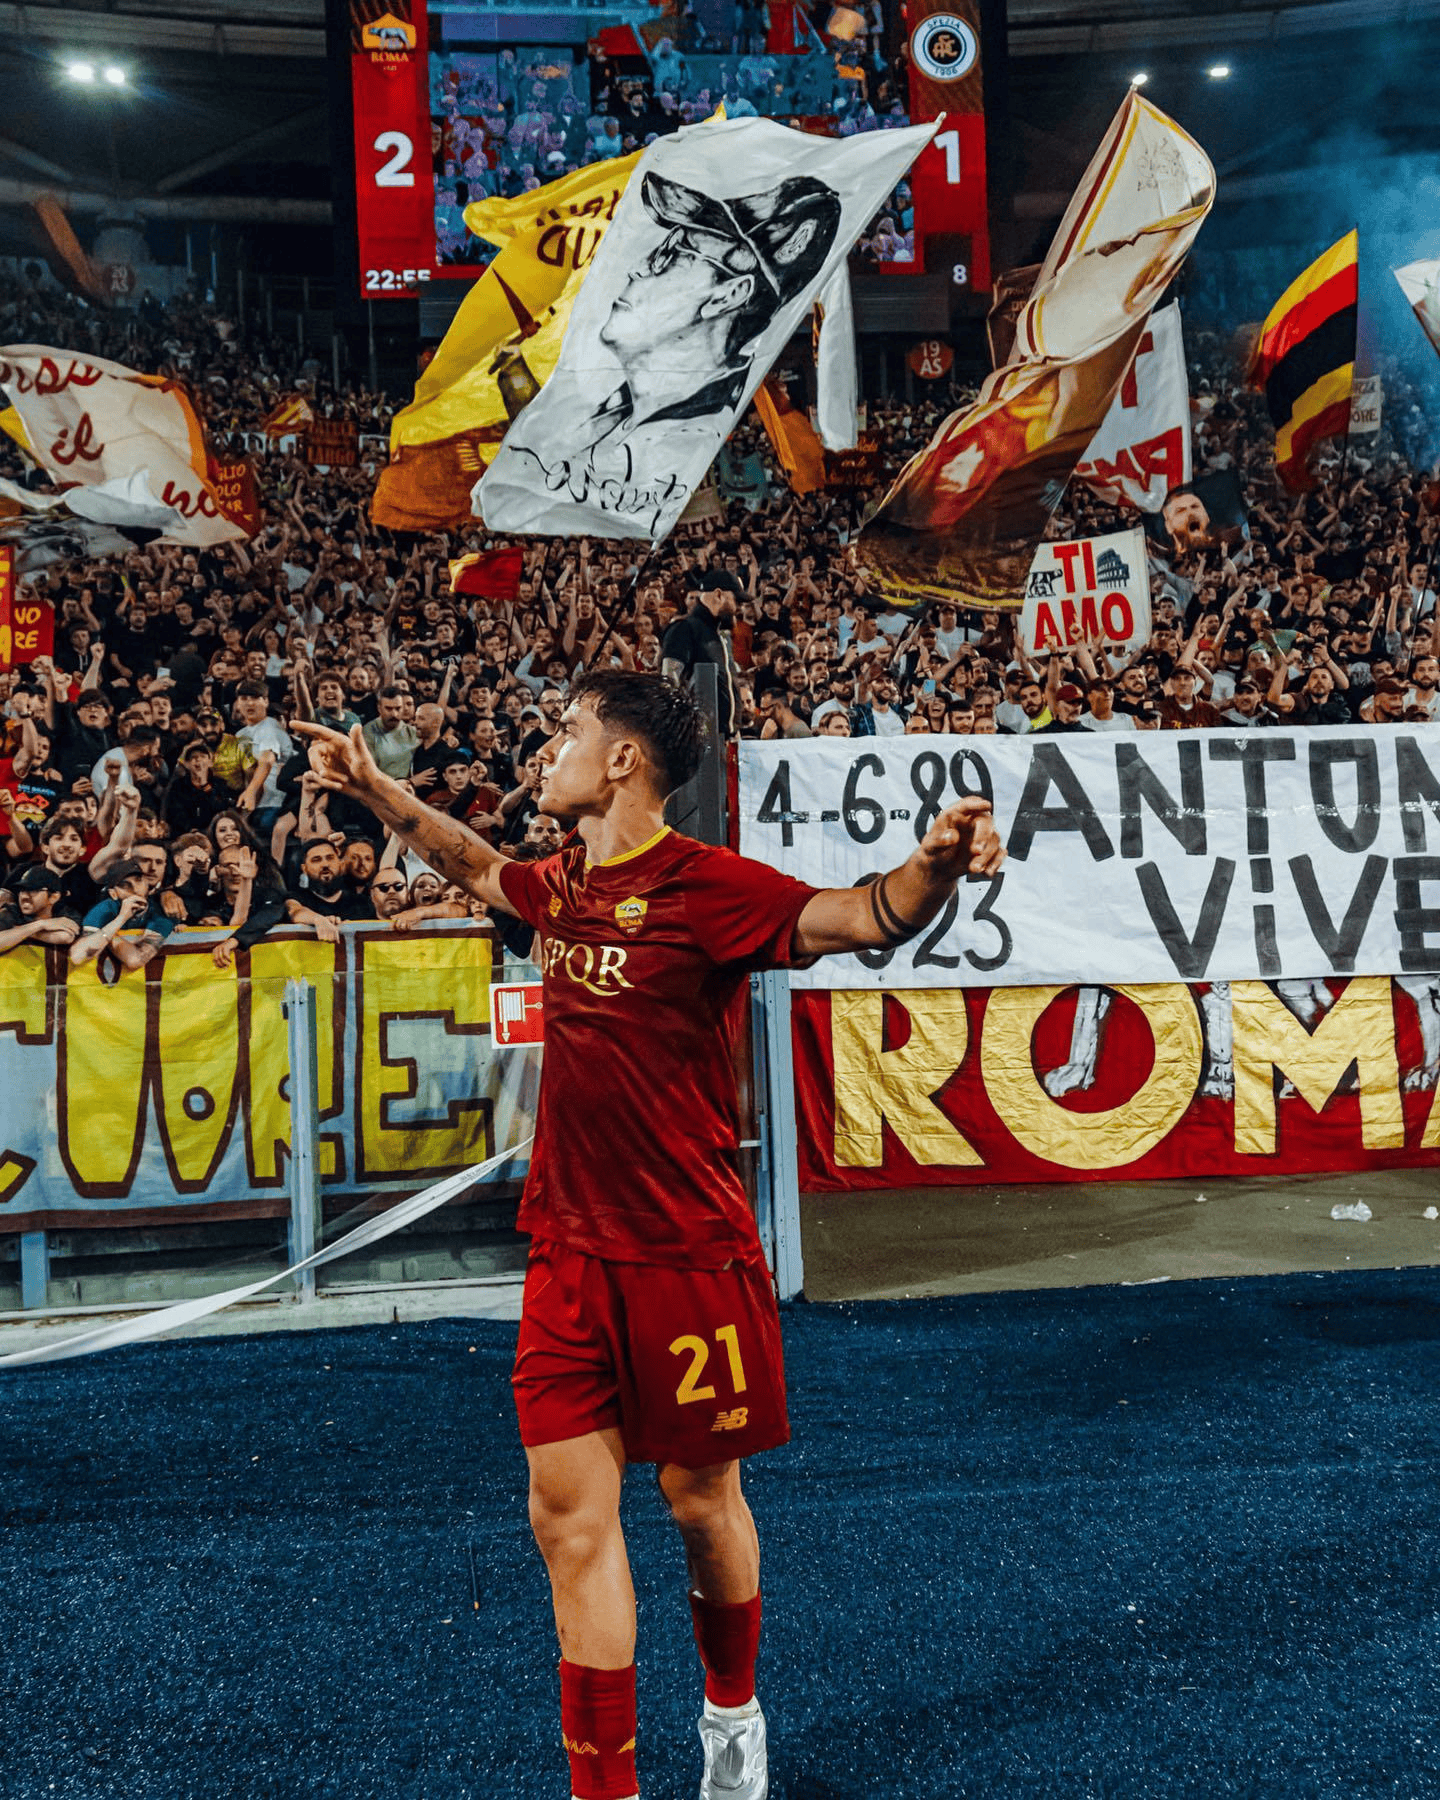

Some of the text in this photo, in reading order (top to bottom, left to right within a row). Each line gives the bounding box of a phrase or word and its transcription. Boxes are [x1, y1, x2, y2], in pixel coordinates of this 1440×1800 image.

[927, 18, 961, 30] SPEZIA
[371, 52, 409, 62] ROMA
[374, 130, 415, 187] 2
[933, 129, 960, 184] 1
[920, 358, 943, 375] AS
[921, 341, 940, 357] 19
[1052, 541, 1097, 594] TI
[14, 630, 39, 649] RE
[1033, 592, 1134, 651] AMO
[831, 982, 1440, 1170] ROM
[669, 1324, 747, 1405] 21
